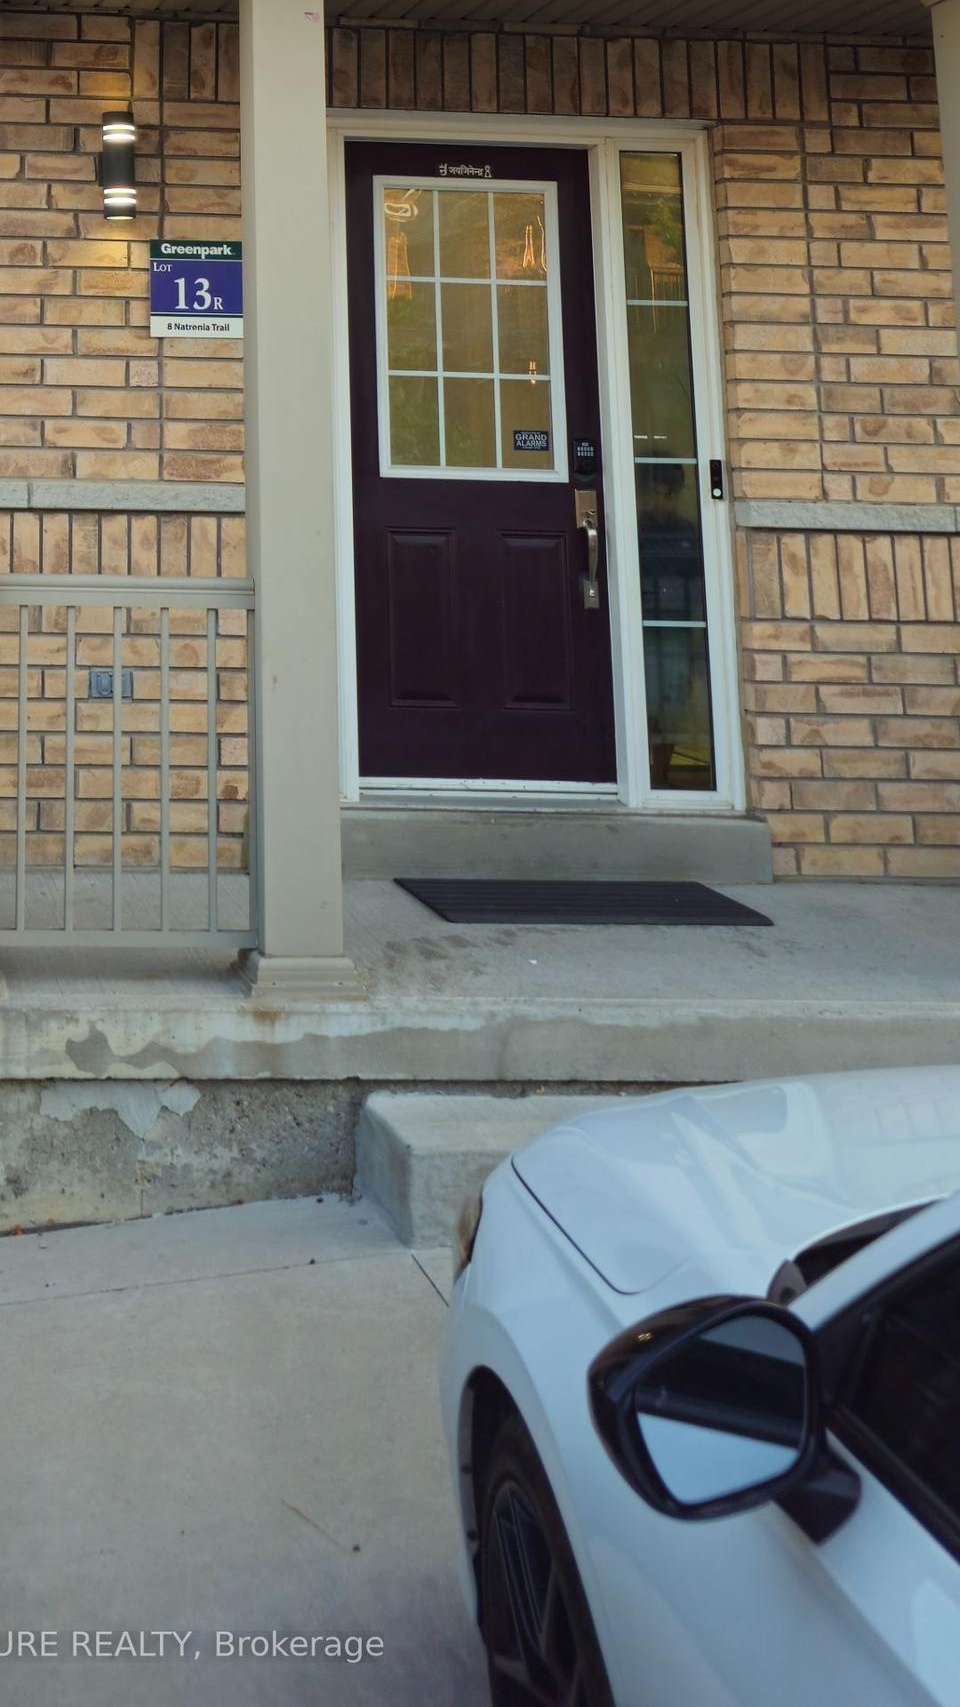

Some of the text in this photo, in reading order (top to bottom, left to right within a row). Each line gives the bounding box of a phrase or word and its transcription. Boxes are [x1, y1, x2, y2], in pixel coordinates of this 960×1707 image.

[160, 243, 232, 259] Greenpark
[167, 322, 173, 330] 8
[211, 323, 230, 331] Trail
[515, 433, 547, 441] GRAND
